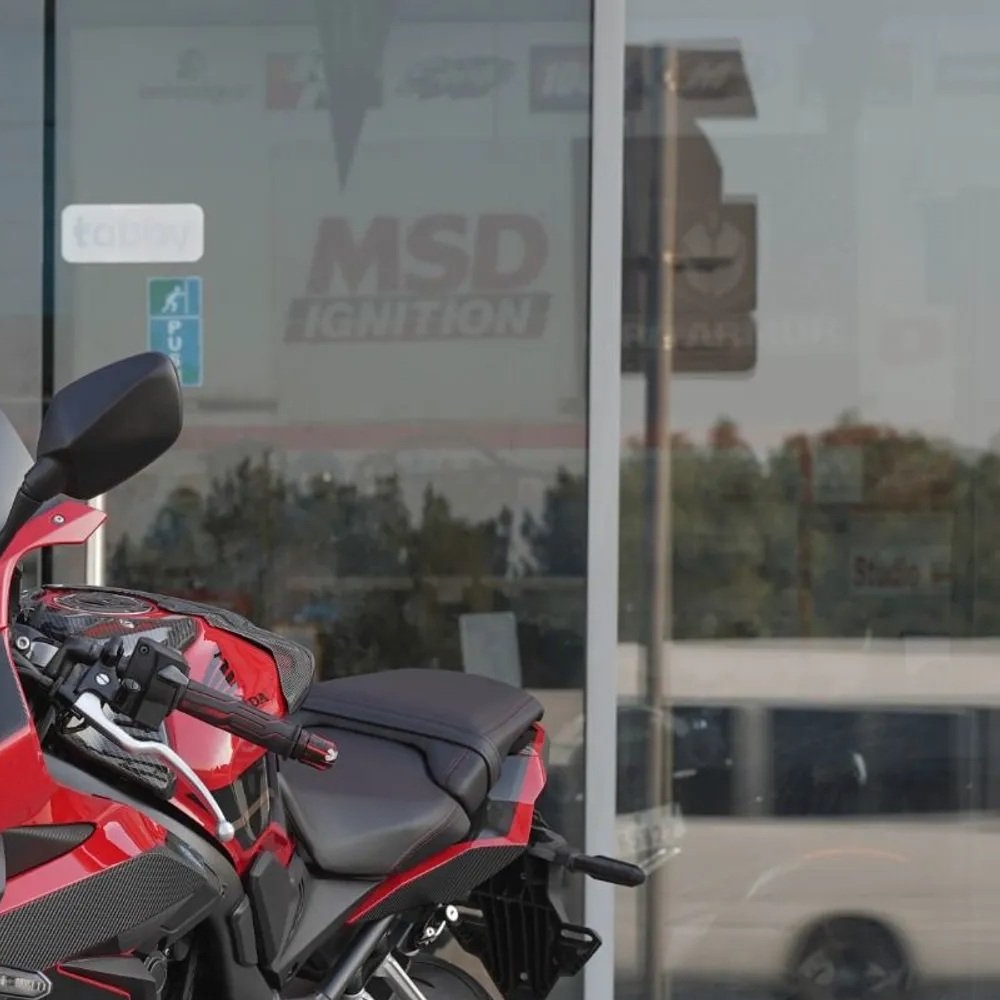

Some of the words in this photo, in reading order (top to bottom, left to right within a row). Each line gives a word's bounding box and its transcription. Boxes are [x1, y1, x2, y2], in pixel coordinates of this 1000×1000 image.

[305, 214, 548, 297] MSD
[303, 299, 532, 338] IGNITION
[167, 320, 182, 382] PUS
